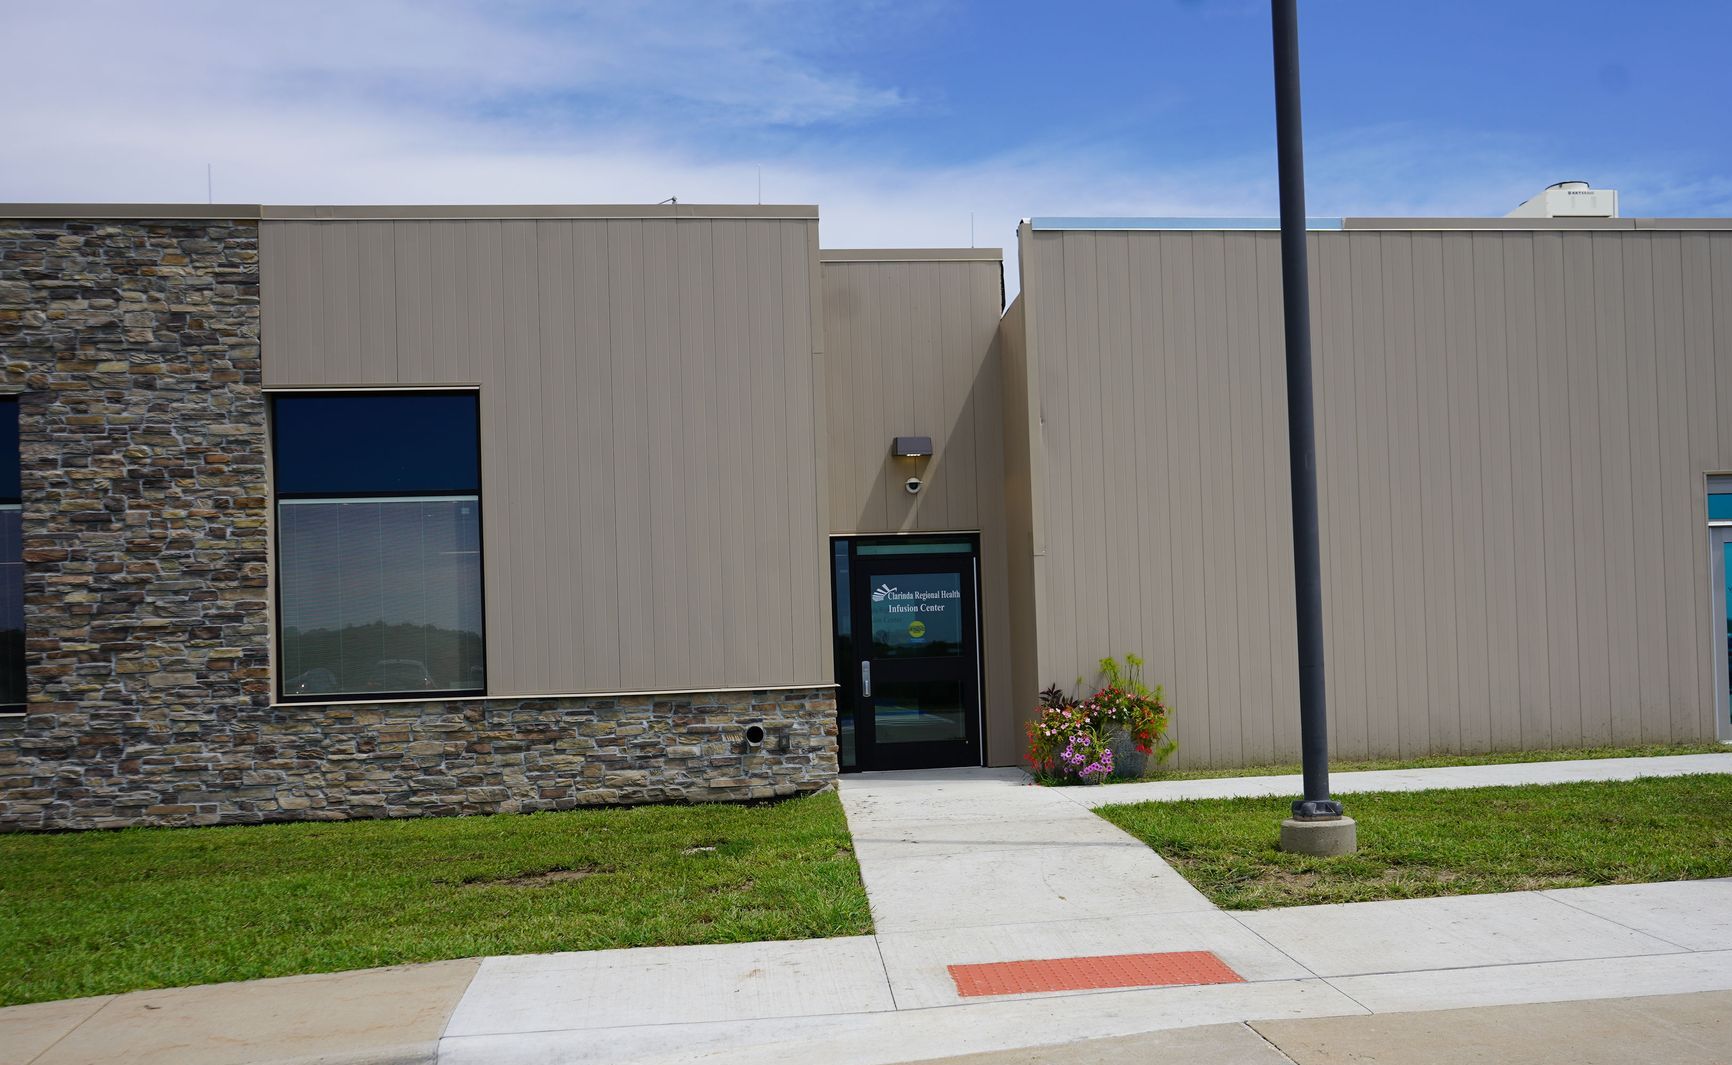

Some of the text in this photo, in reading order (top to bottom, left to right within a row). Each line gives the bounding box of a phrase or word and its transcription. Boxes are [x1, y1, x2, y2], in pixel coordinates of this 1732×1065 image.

[887, 590, 961, 601] Clarinda Regional Health
[888, 603, 945, 613] Infusion Center
